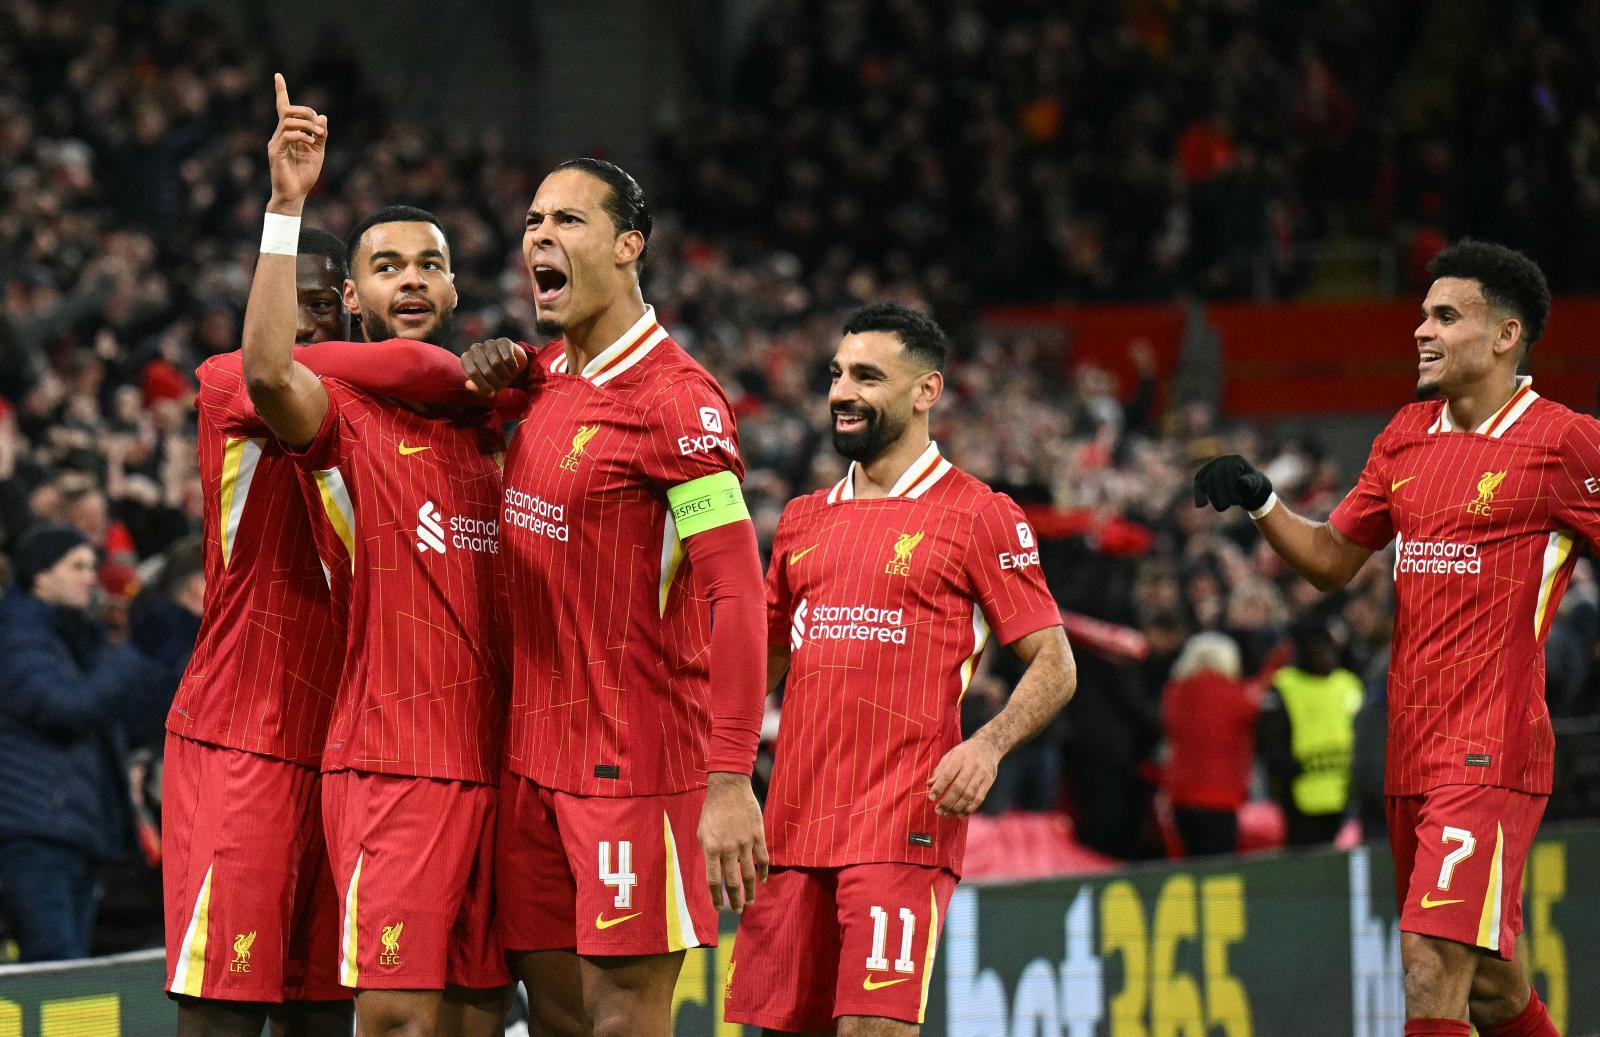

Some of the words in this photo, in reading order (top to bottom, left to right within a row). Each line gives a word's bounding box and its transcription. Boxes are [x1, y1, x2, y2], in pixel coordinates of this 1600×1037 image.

[1584, 477, 1600, 494] E
[504, 486, 563, 522] standard
[674, 498, 711, 519] ESPECT
[449, 514, 499, 536] stand
[504, 507, 569, 542] chartered
[999, 549, 1040, 571] Expe
[1404, 539, 1477, 558] standard
[1400, 555, 1481, 574] chartered
[812, 603, 903, 626] standard
[809, 621, 907, 645] chartered
[1437, 825, 1477, 891] 7
[598, 841, 637, 909] 4
[865, 906, 916, 974] 11
